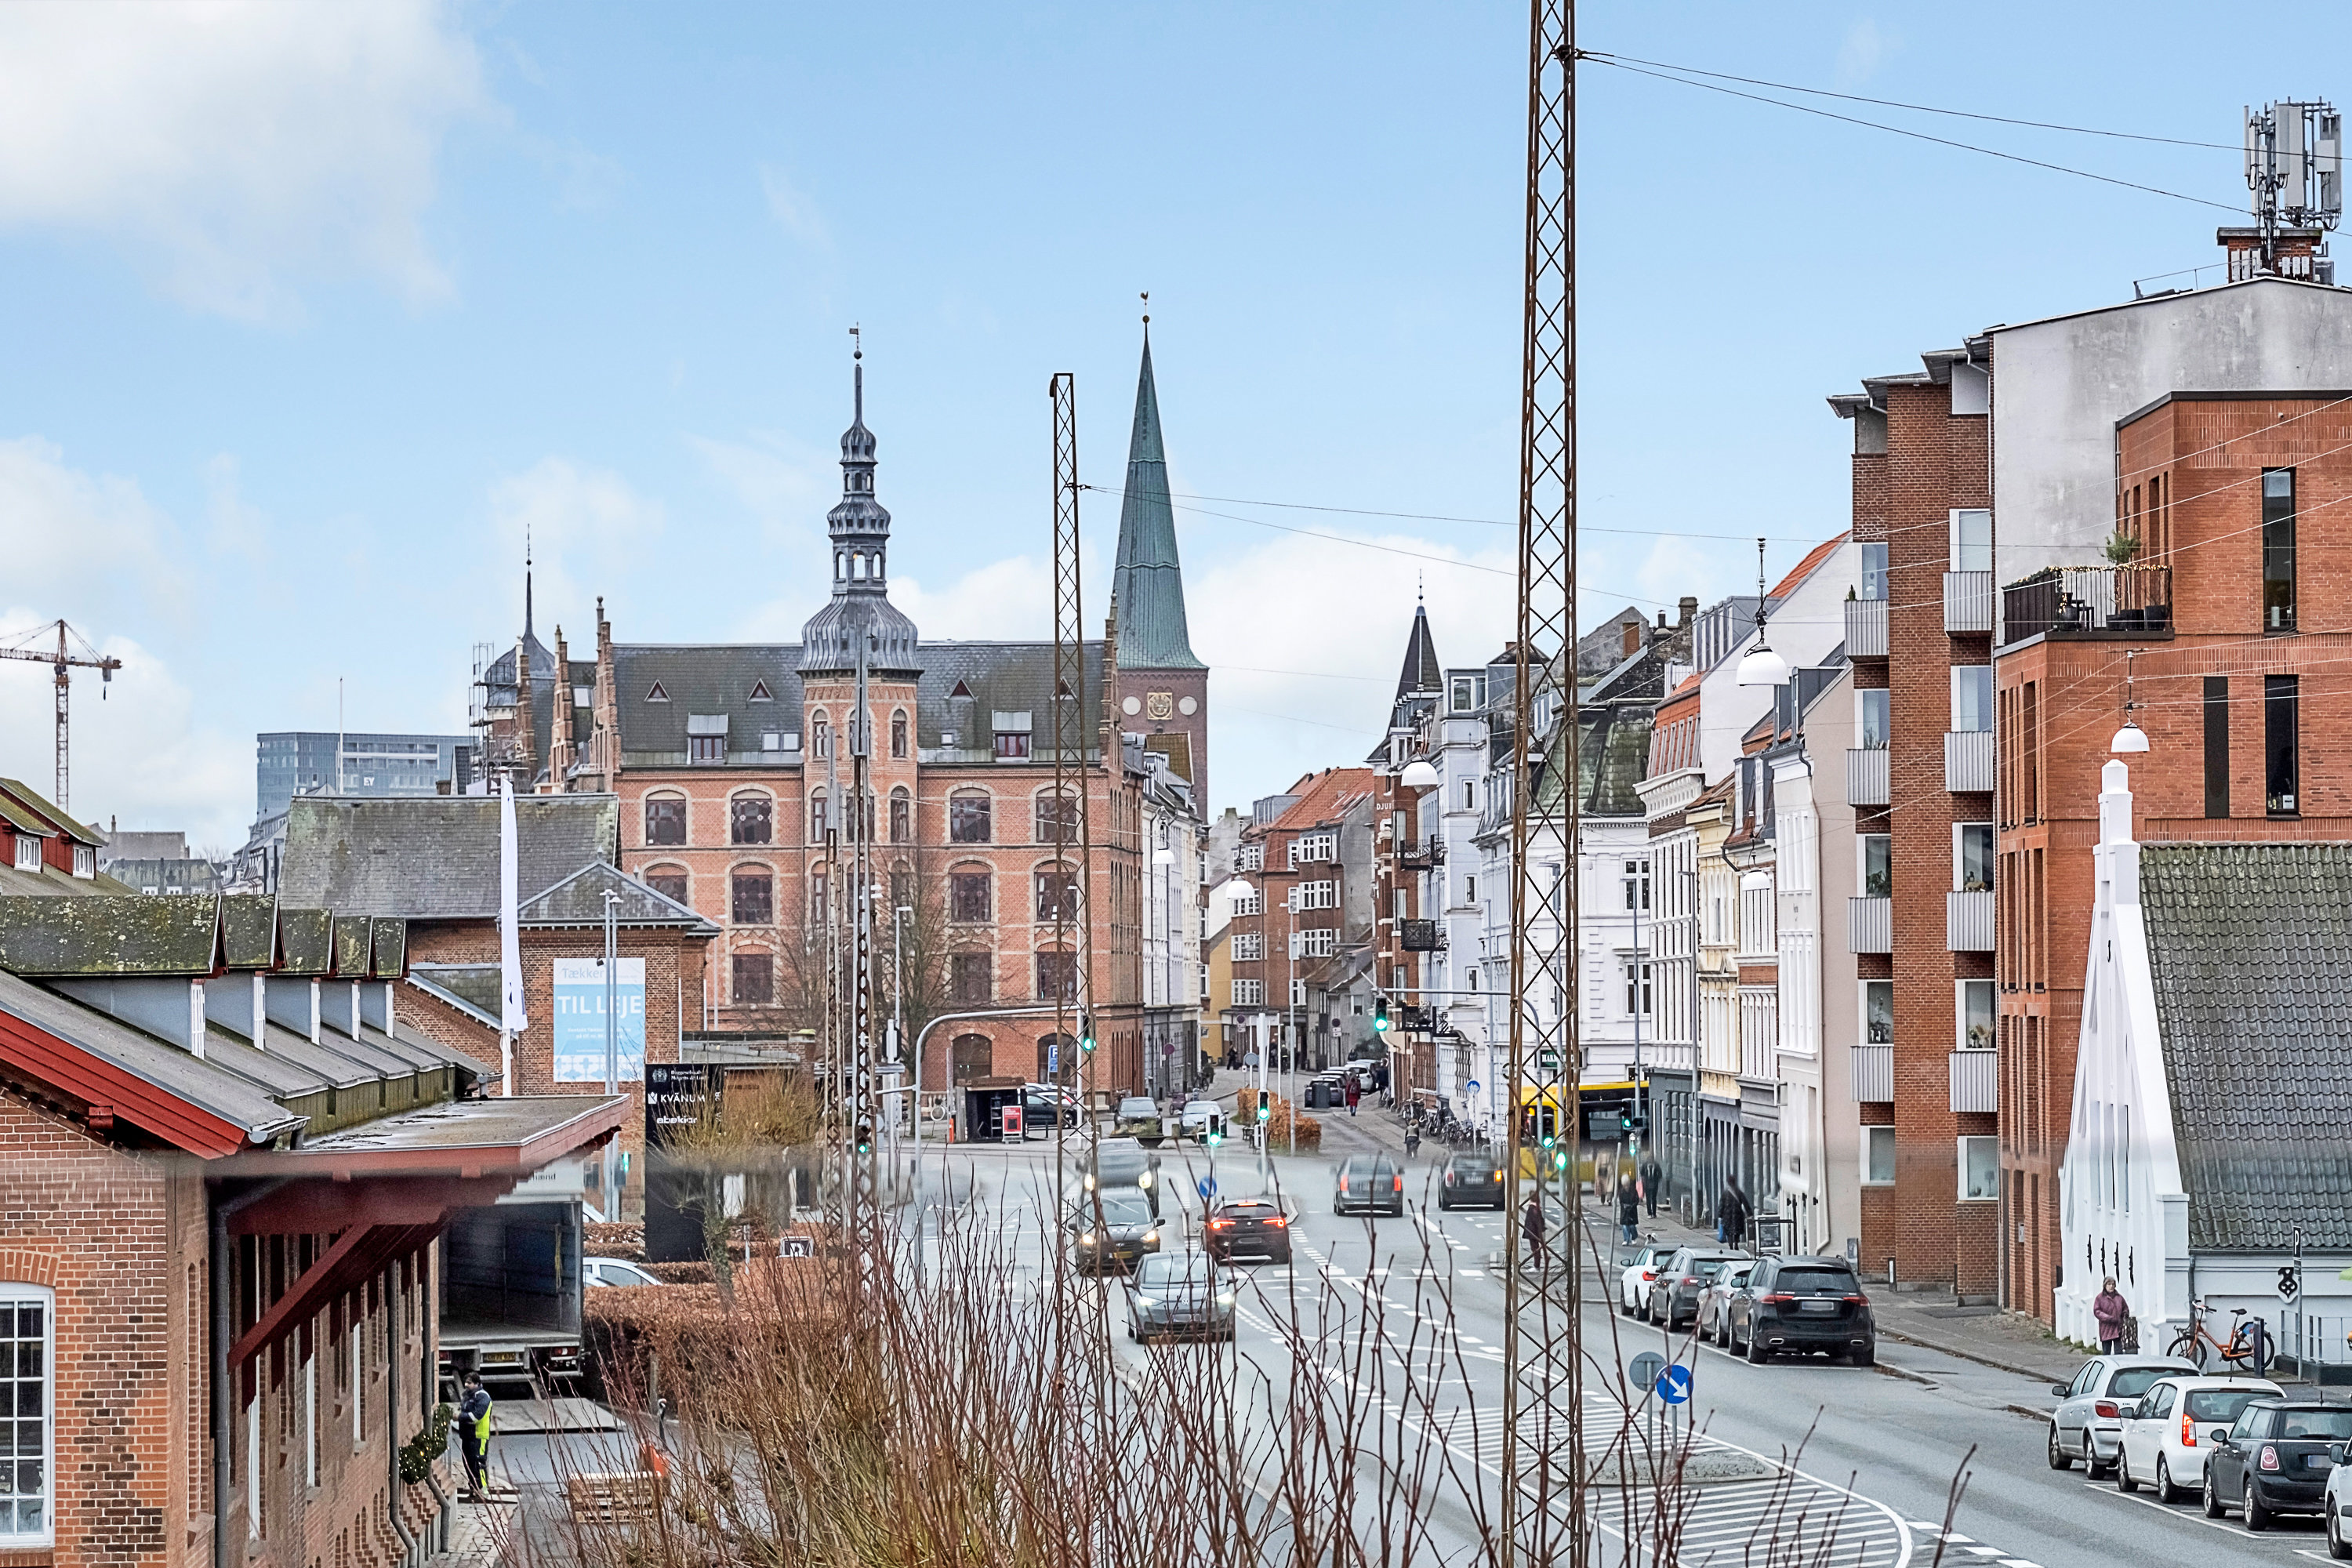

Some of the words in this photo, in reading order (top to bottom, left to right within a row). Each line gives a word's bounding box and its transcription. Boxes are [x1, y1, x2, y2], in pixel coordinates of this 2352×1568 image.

[363, 777, 375, 786] EY
[561, 967, 604, 979] Tækker
[557, 995, 591, 1014] TIL
[596, 995, 642, 1019] LEJE
